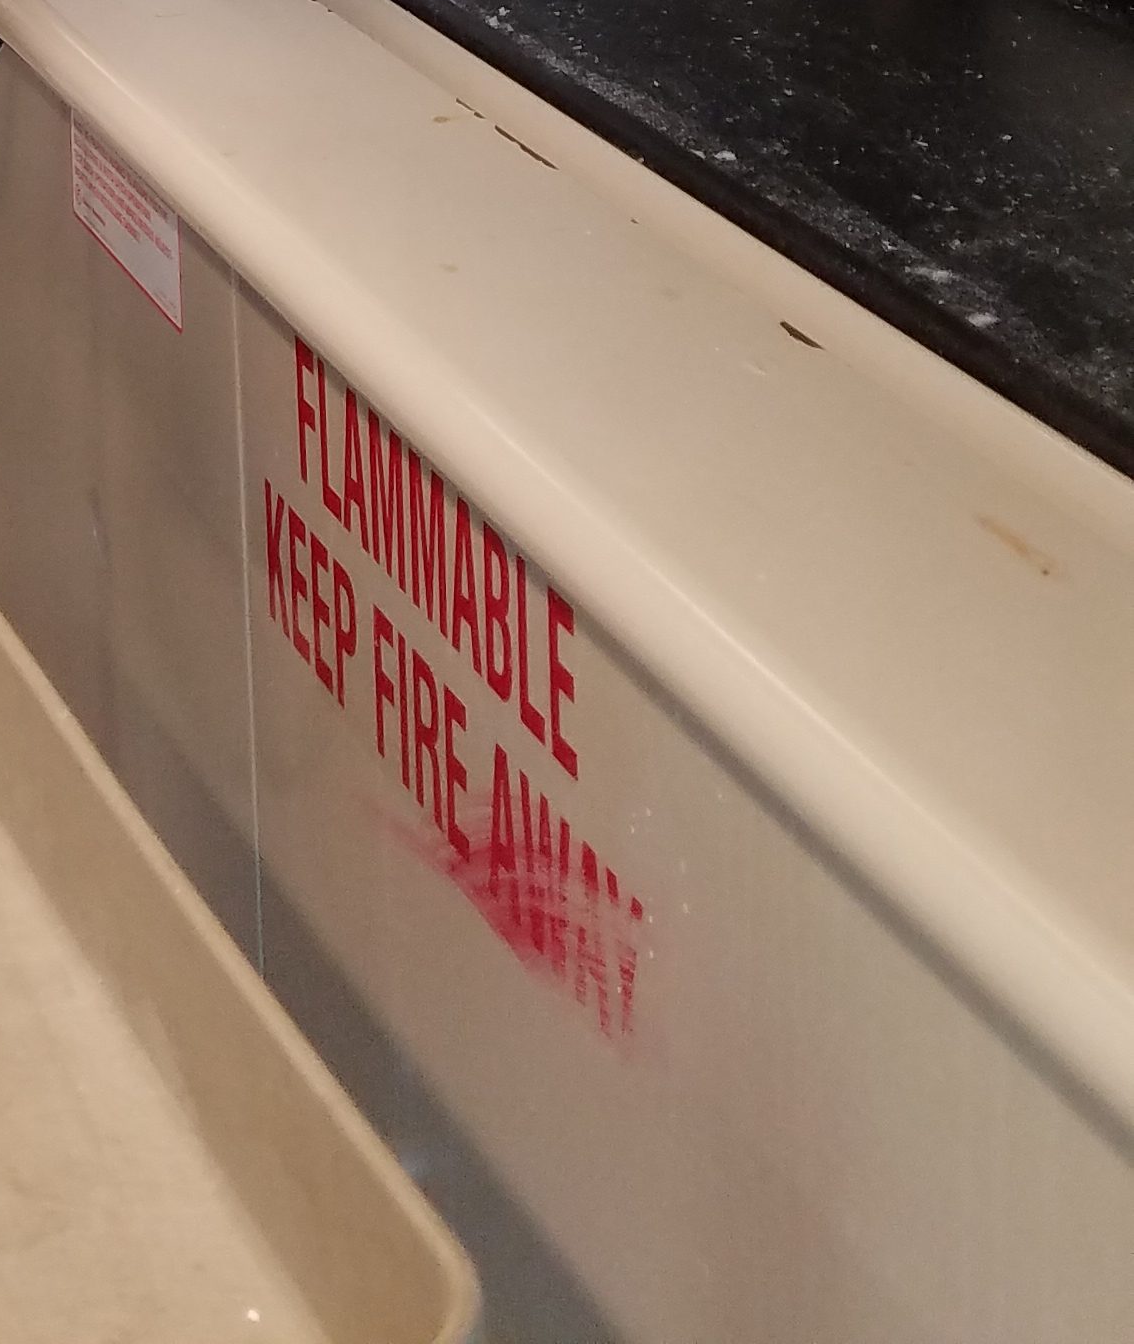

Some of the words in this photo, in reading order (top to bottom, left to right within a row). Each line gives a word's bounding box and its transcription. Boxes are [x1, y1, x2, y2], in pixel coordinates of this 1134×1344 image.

[264, 477, 357, 709] KEEP
[373, 602, 471, 865] FIRE
[295, 334, 580, 781] FLAMMABLE
